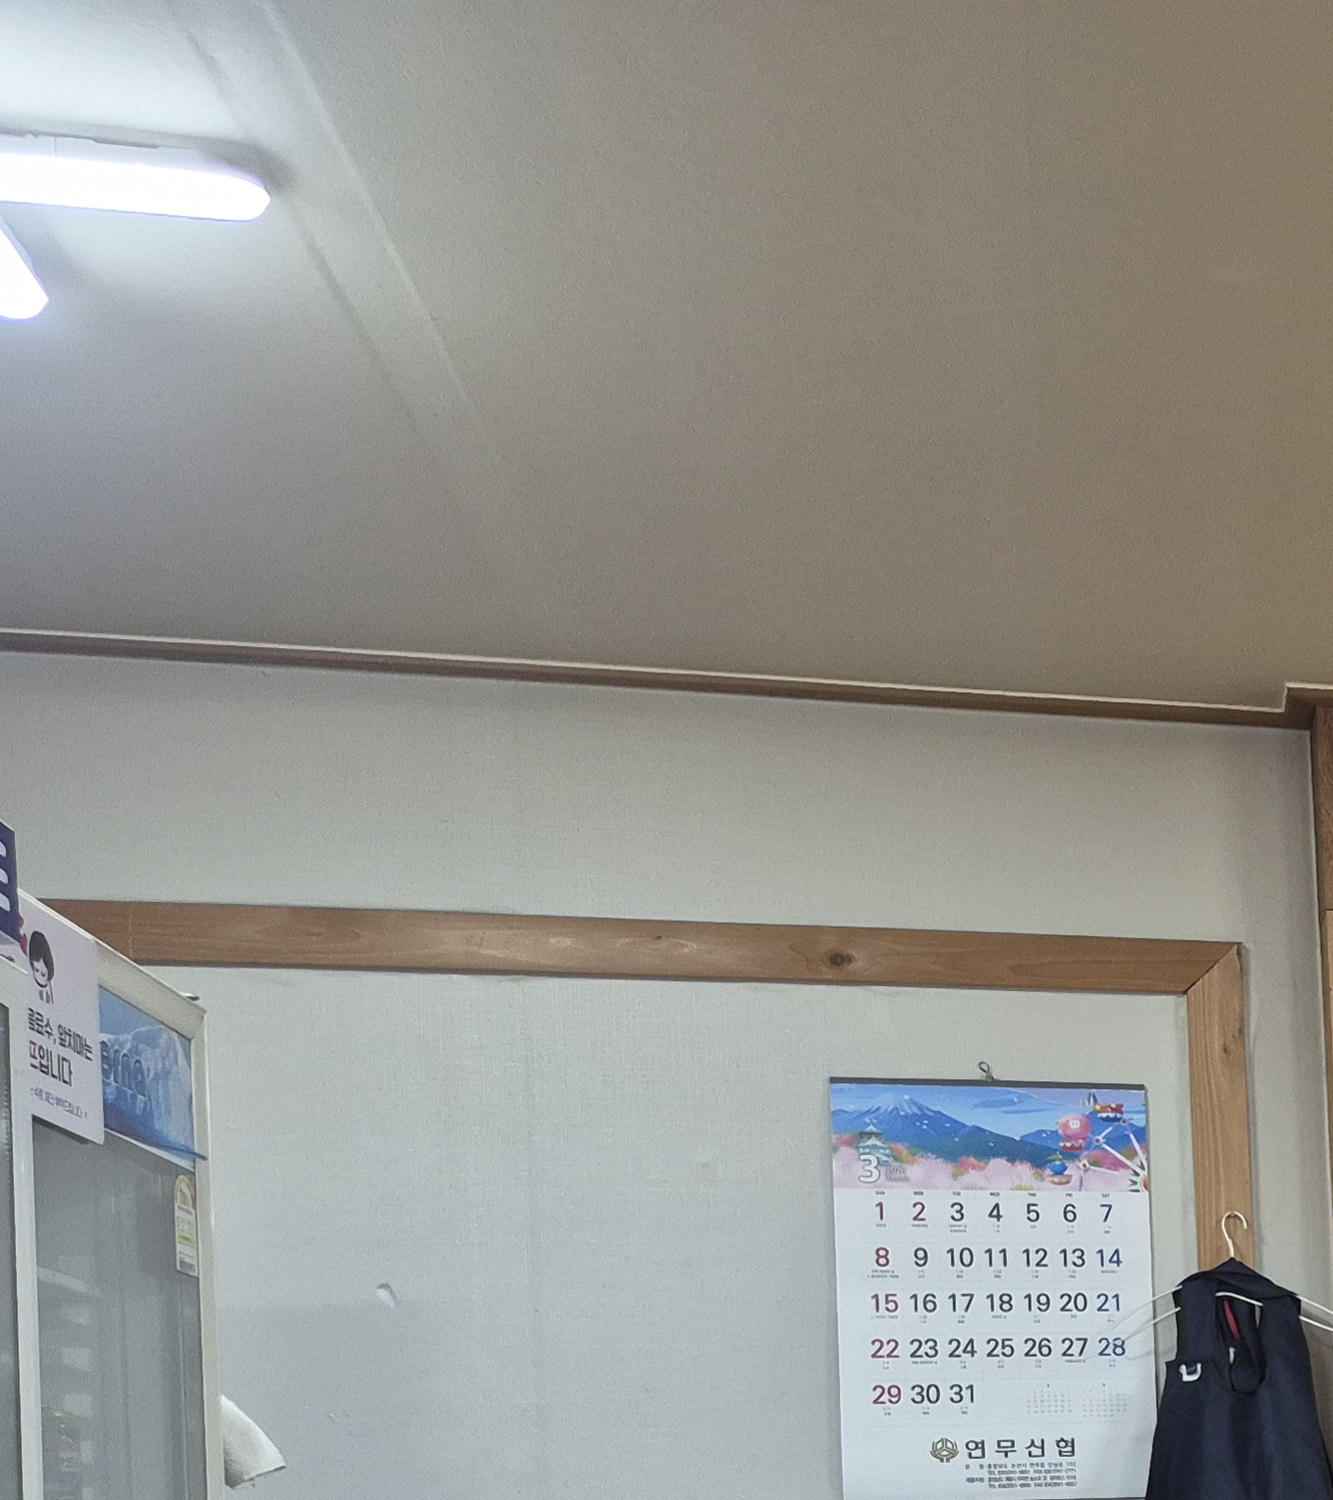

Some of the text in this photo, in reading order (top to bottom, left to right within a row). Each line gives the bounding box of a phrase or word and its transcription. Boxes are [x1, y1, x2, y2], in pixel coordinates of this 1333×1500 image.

[858, 1153, 881, 1184] 3
[875, 1201, 1113, 1223] 1 2 3 4 5 6 7
[874, 1246, 1123, 1268] 8 9 10 11 12 13 14
[870, 1292, 1121, 1314] 15 16 17 18 19 20 21
[870, 1337, 1125, 1359] 22 23 24 25 26 27 28
[871, 1383, 975, 1405] 29 30 31
